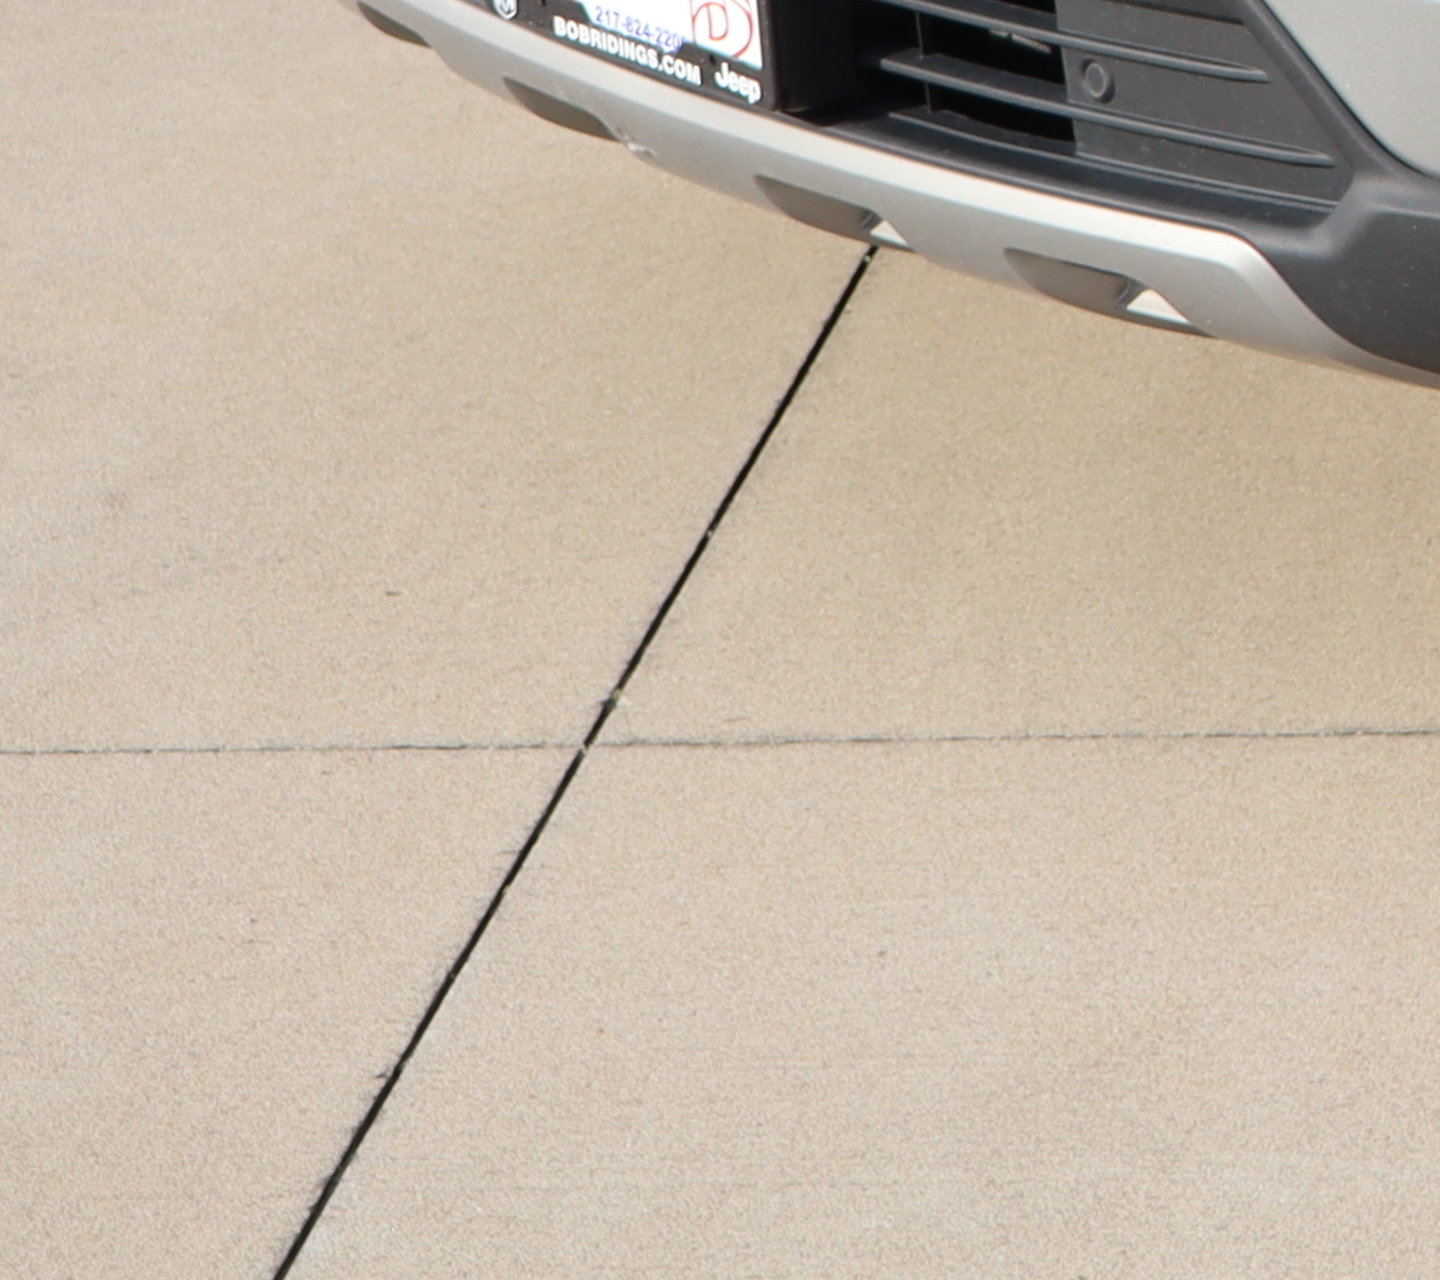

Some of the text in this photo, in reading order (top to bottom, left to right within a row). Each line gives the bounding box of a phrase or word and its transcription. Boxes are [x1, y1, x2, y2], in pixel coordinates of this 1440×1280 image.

[553, 15, 702, 86] BOBRIDINGS.COM
[595, 5, 686, 52] 217-824-220
[714, 61, 762, 105] Jeep
